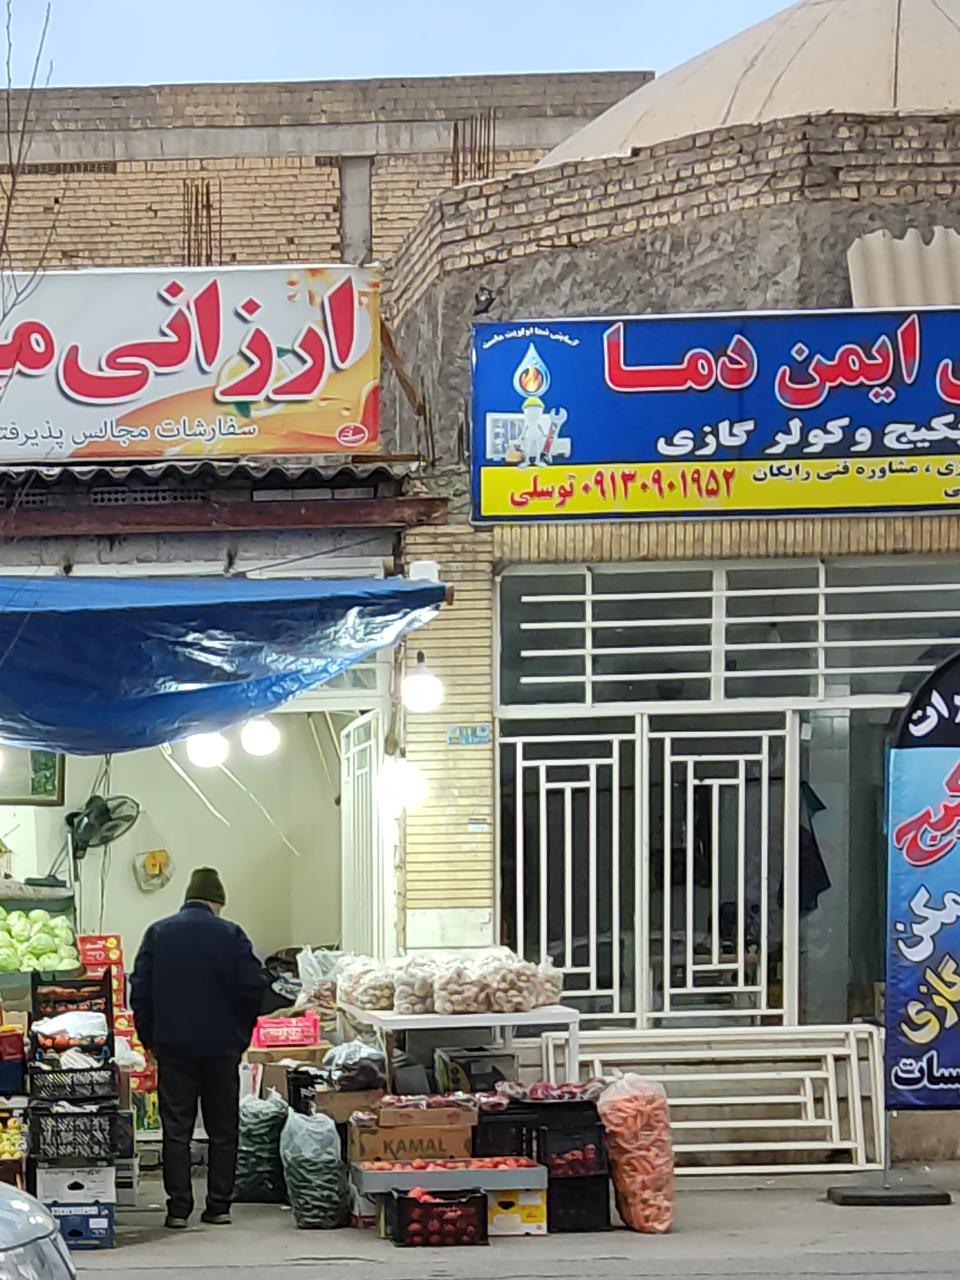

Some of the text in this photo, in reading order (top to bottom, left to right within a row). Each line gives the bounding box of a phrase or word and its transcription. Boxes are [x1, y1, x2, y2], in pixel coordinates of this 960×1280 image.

[60, 275, 358, 403] ارزانی
[603, 322, 758, 391] دما
[775, 314, 920, 409] ایمن
[71, 419, 150, 447] مجالس
[155, 416, 258, 441] سفارشات
[657, 419, 755, 455] گازی
[752, 463, 810, 482] رایگان
[816, 460, 849, 480] فنی
[856, 460, 917, 480] مشاوره
[510, 467, 736, 508] ۰۹۱۳۰۹۰۱۹۵۲ توسلی
[383, 1137, 448, 1160] KAMAL
